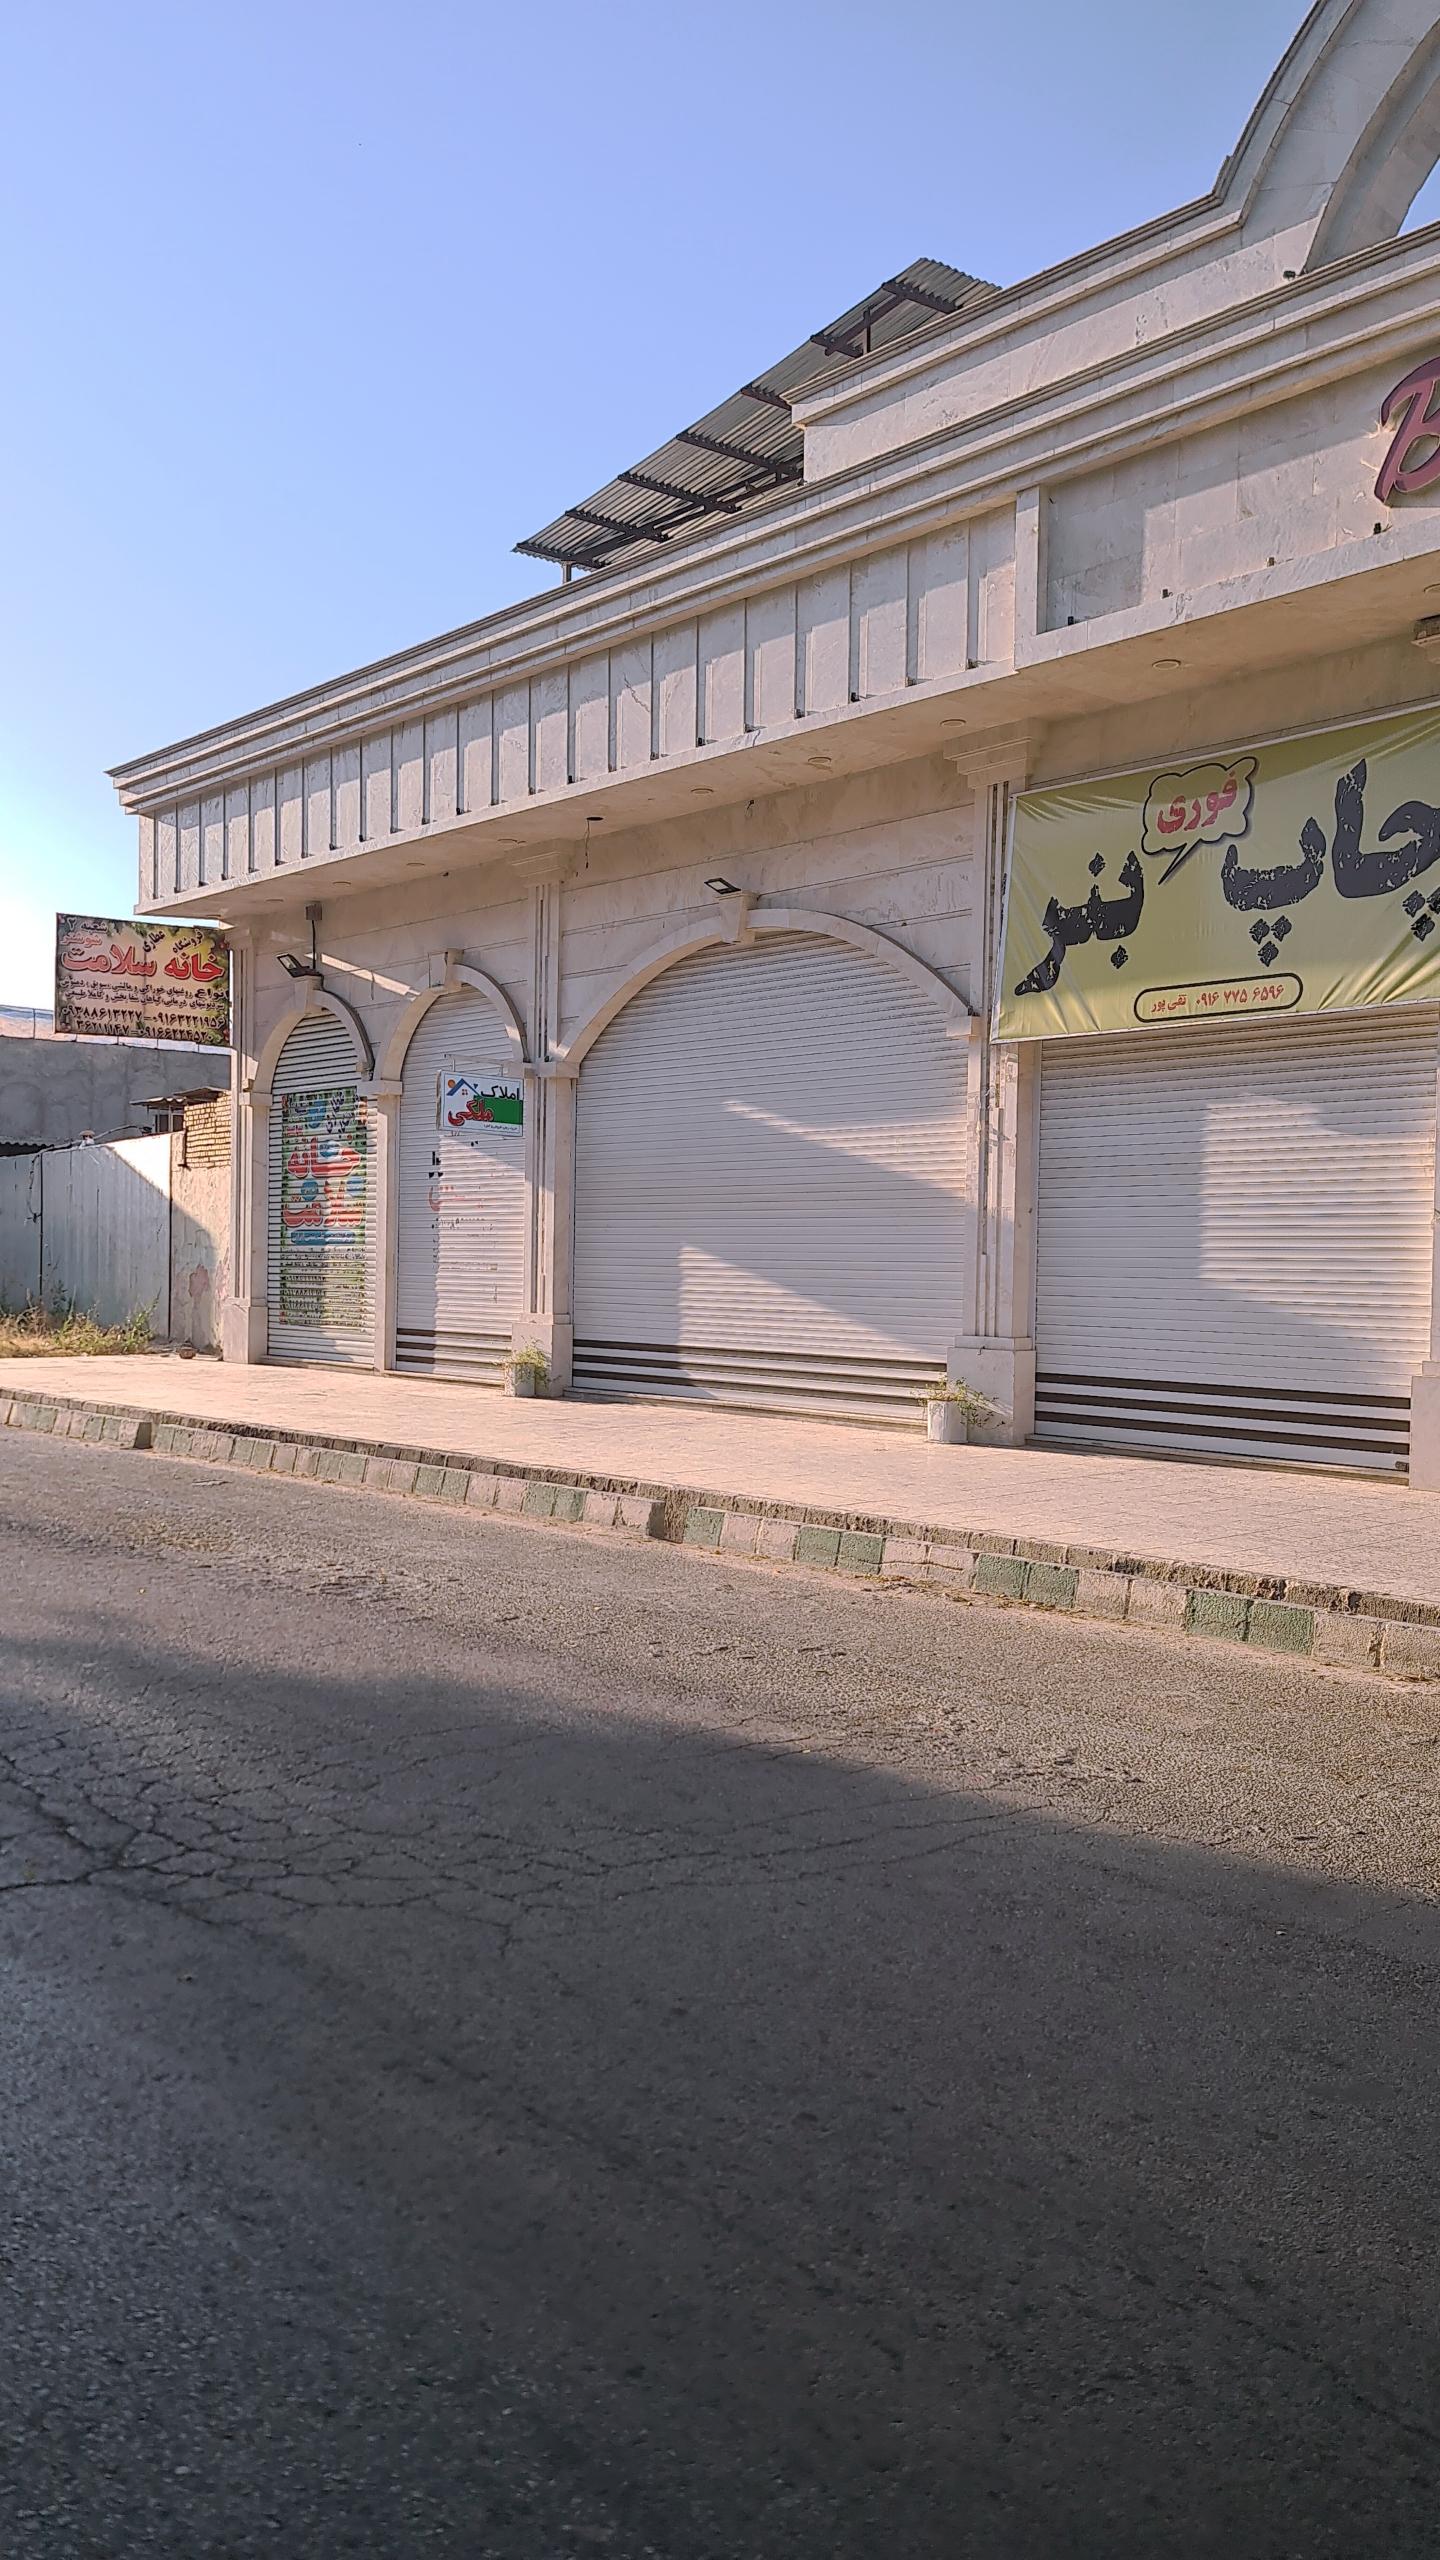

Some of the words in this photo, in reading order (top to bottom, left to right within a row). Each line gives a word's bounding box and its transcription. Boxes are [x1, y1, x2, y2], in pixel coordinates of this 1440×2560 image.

[1156, 770, 1238, 835] فوری
[1014, 850, 1145, 997] بنر
[143, 930, 166, 953] عطاری
[172, 929, 204, 953] فروشگاه
[61, 944, 157, 977] سلامت
[164, 951, 225, 982] خانه
[194, 987, 230, 1001] انواع
[1196, 991, 1220, 1006] ۰۹۱۶
[1223, 988, 1248, 1004] ۷۷۵
[1252, 984, 1285, 1002] ۶۵۹۶
[481, 1085, 520, 1101] املاک
[447, 1099, 494, 1126] ملکی
